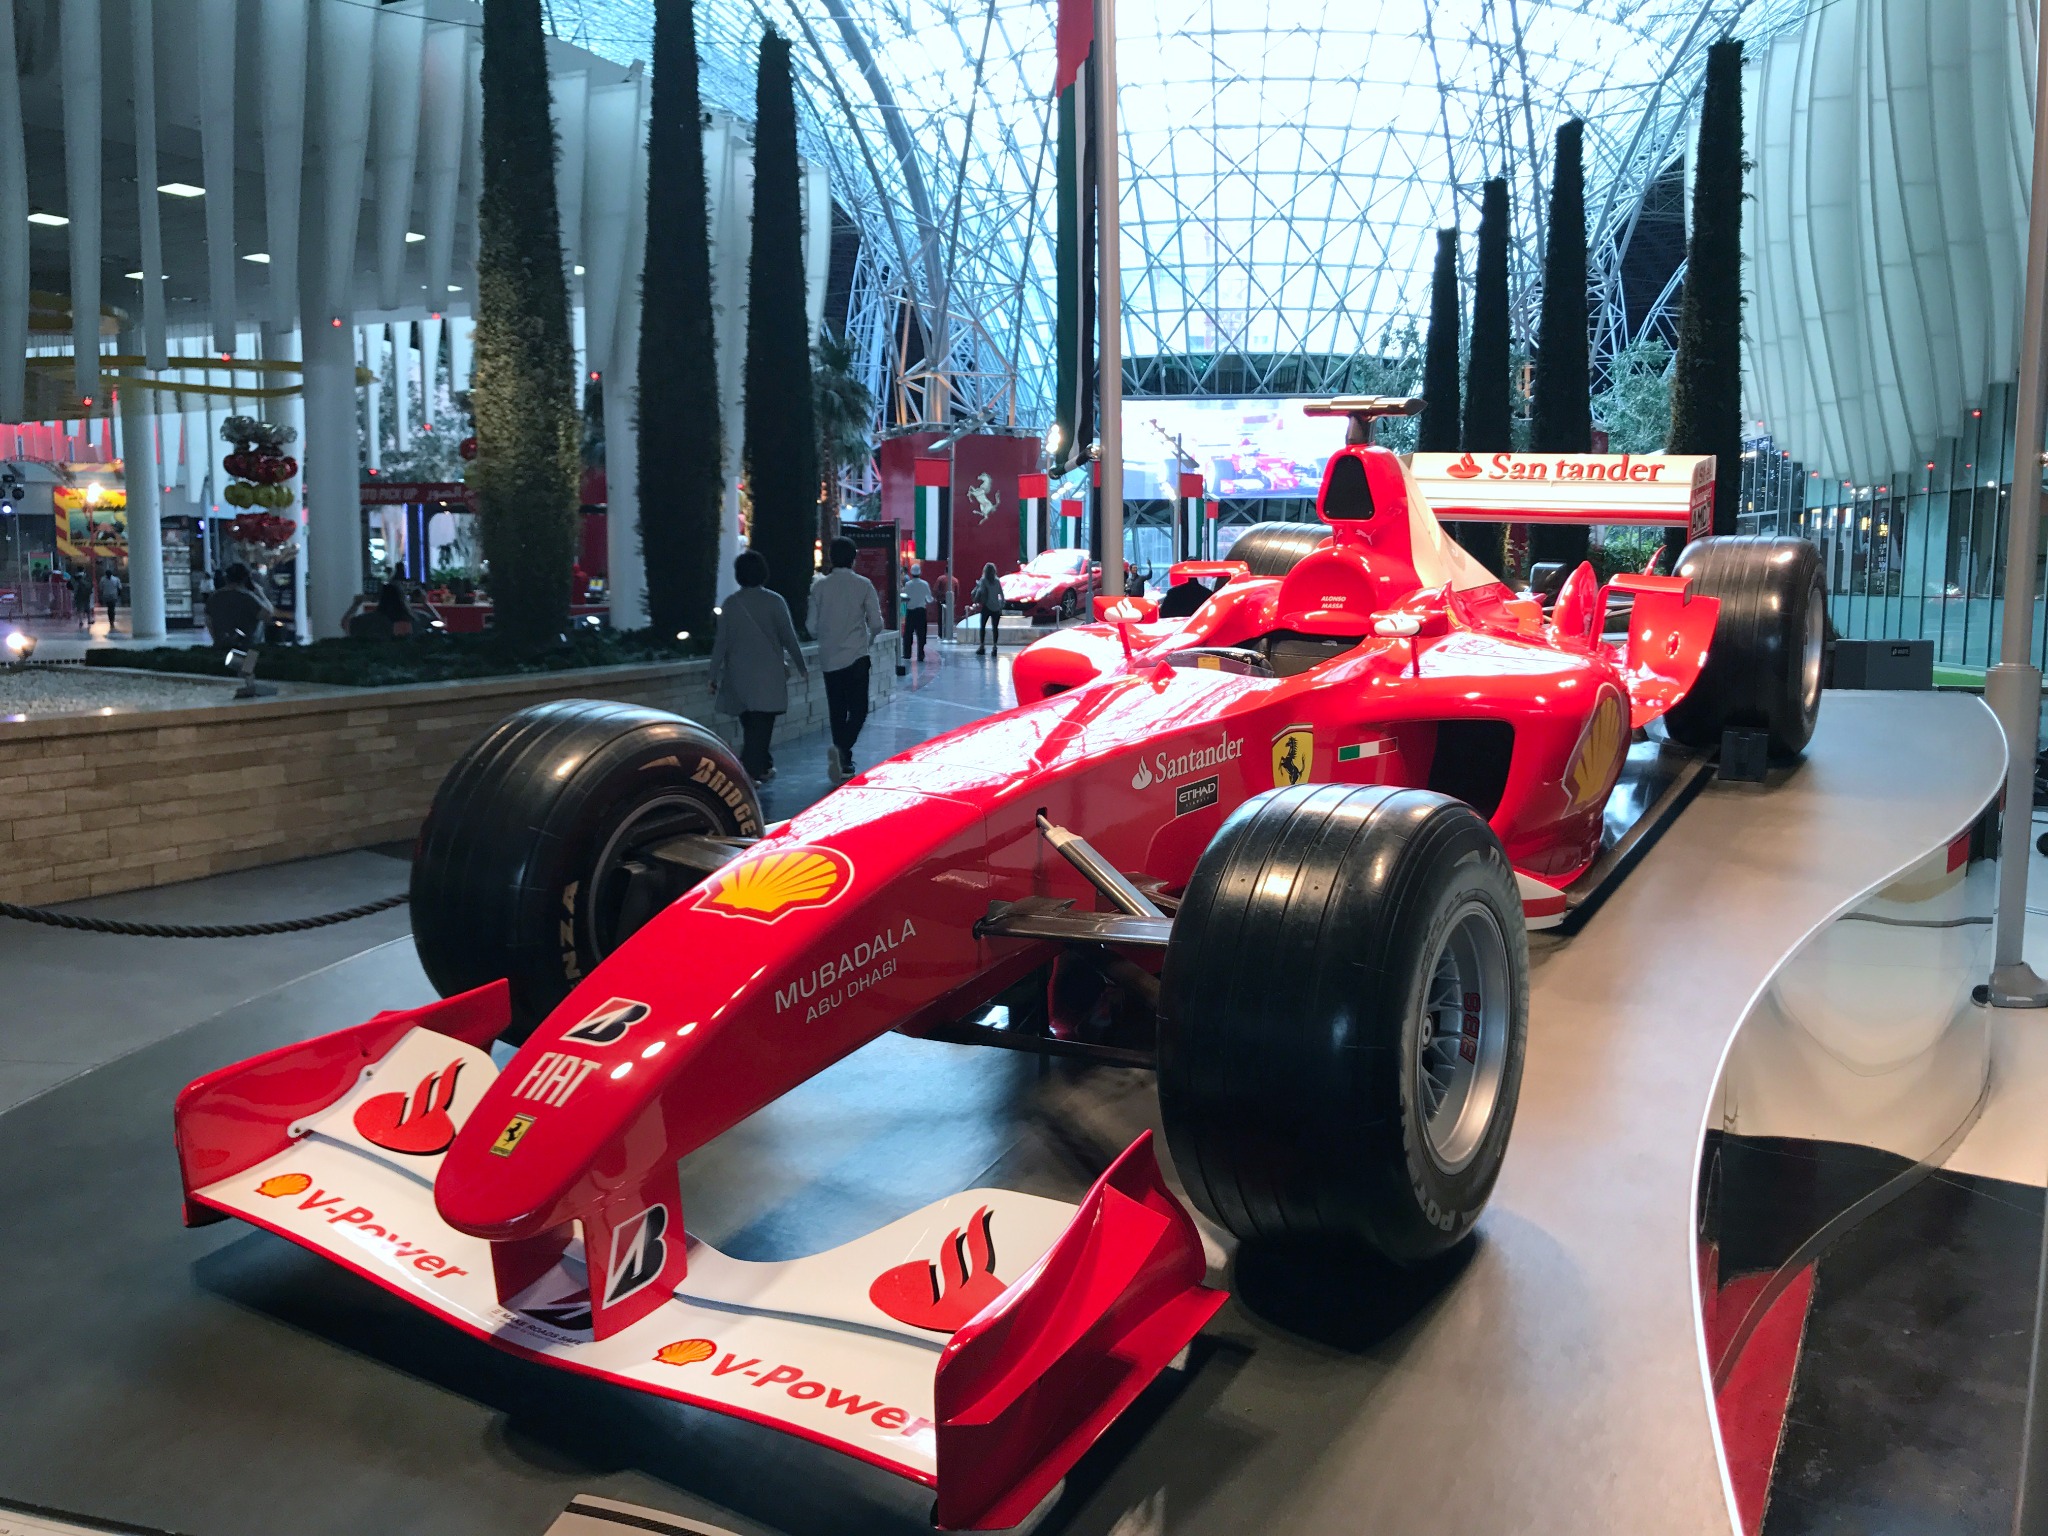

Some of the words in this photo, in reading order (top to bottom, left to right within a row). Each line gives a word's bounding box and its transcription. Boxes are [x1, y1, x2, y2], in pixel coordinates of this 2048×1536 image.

[1155, 730, 1244, 784] Santander
[690, 756, 758, 839] BRIDGE
[1178, 783, 1216, 803] ETIHAD
[774, 918, 917, 1014] MUBADALA
[805, 989, 843, 1024] ABU
[847, 957, 898, 998] DHABI
[511, 1052, 603, 1108] FIAT
[710, 1352, 937, 1437] V-Power
